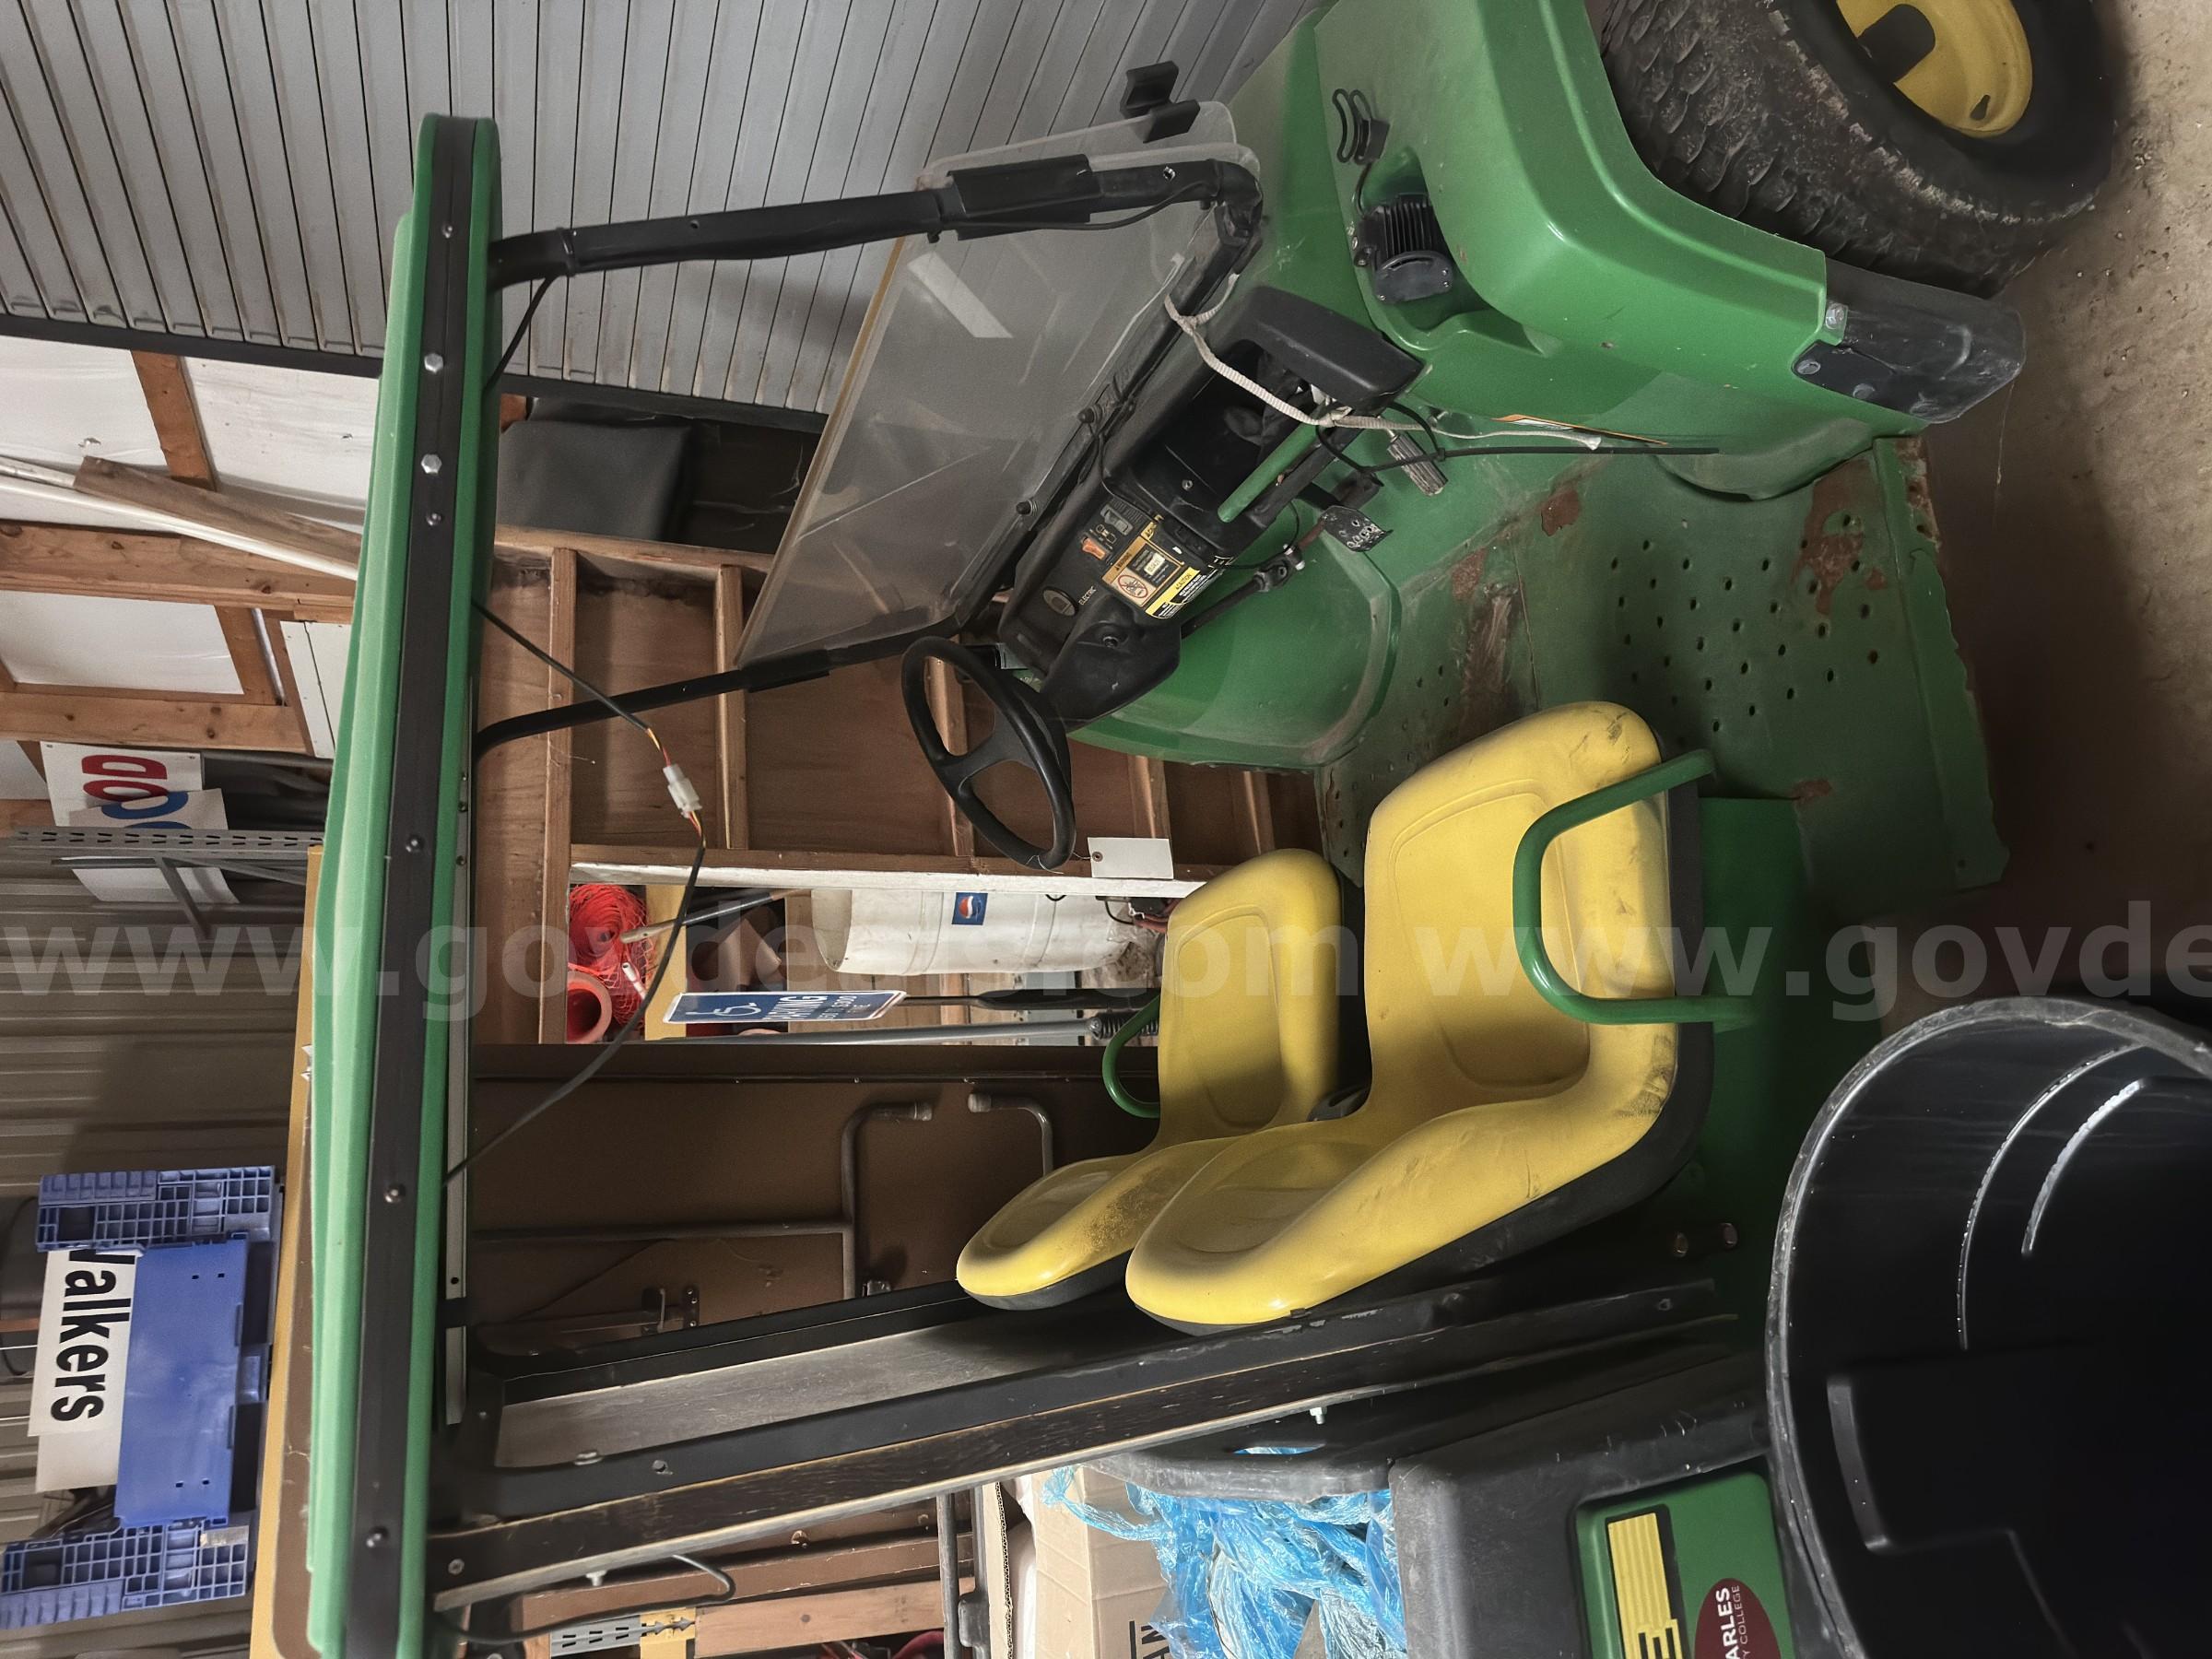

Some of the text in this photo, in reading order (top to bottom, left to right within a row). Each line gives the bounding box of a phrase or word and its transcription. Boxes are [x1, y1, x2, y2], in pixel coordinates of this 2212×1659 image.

[1078, 585, 1097, 606] ELECTRIC
[762, 995, 828, 1020] PARKING
[1732, 1585, 1748, 1644] COLLEGE
